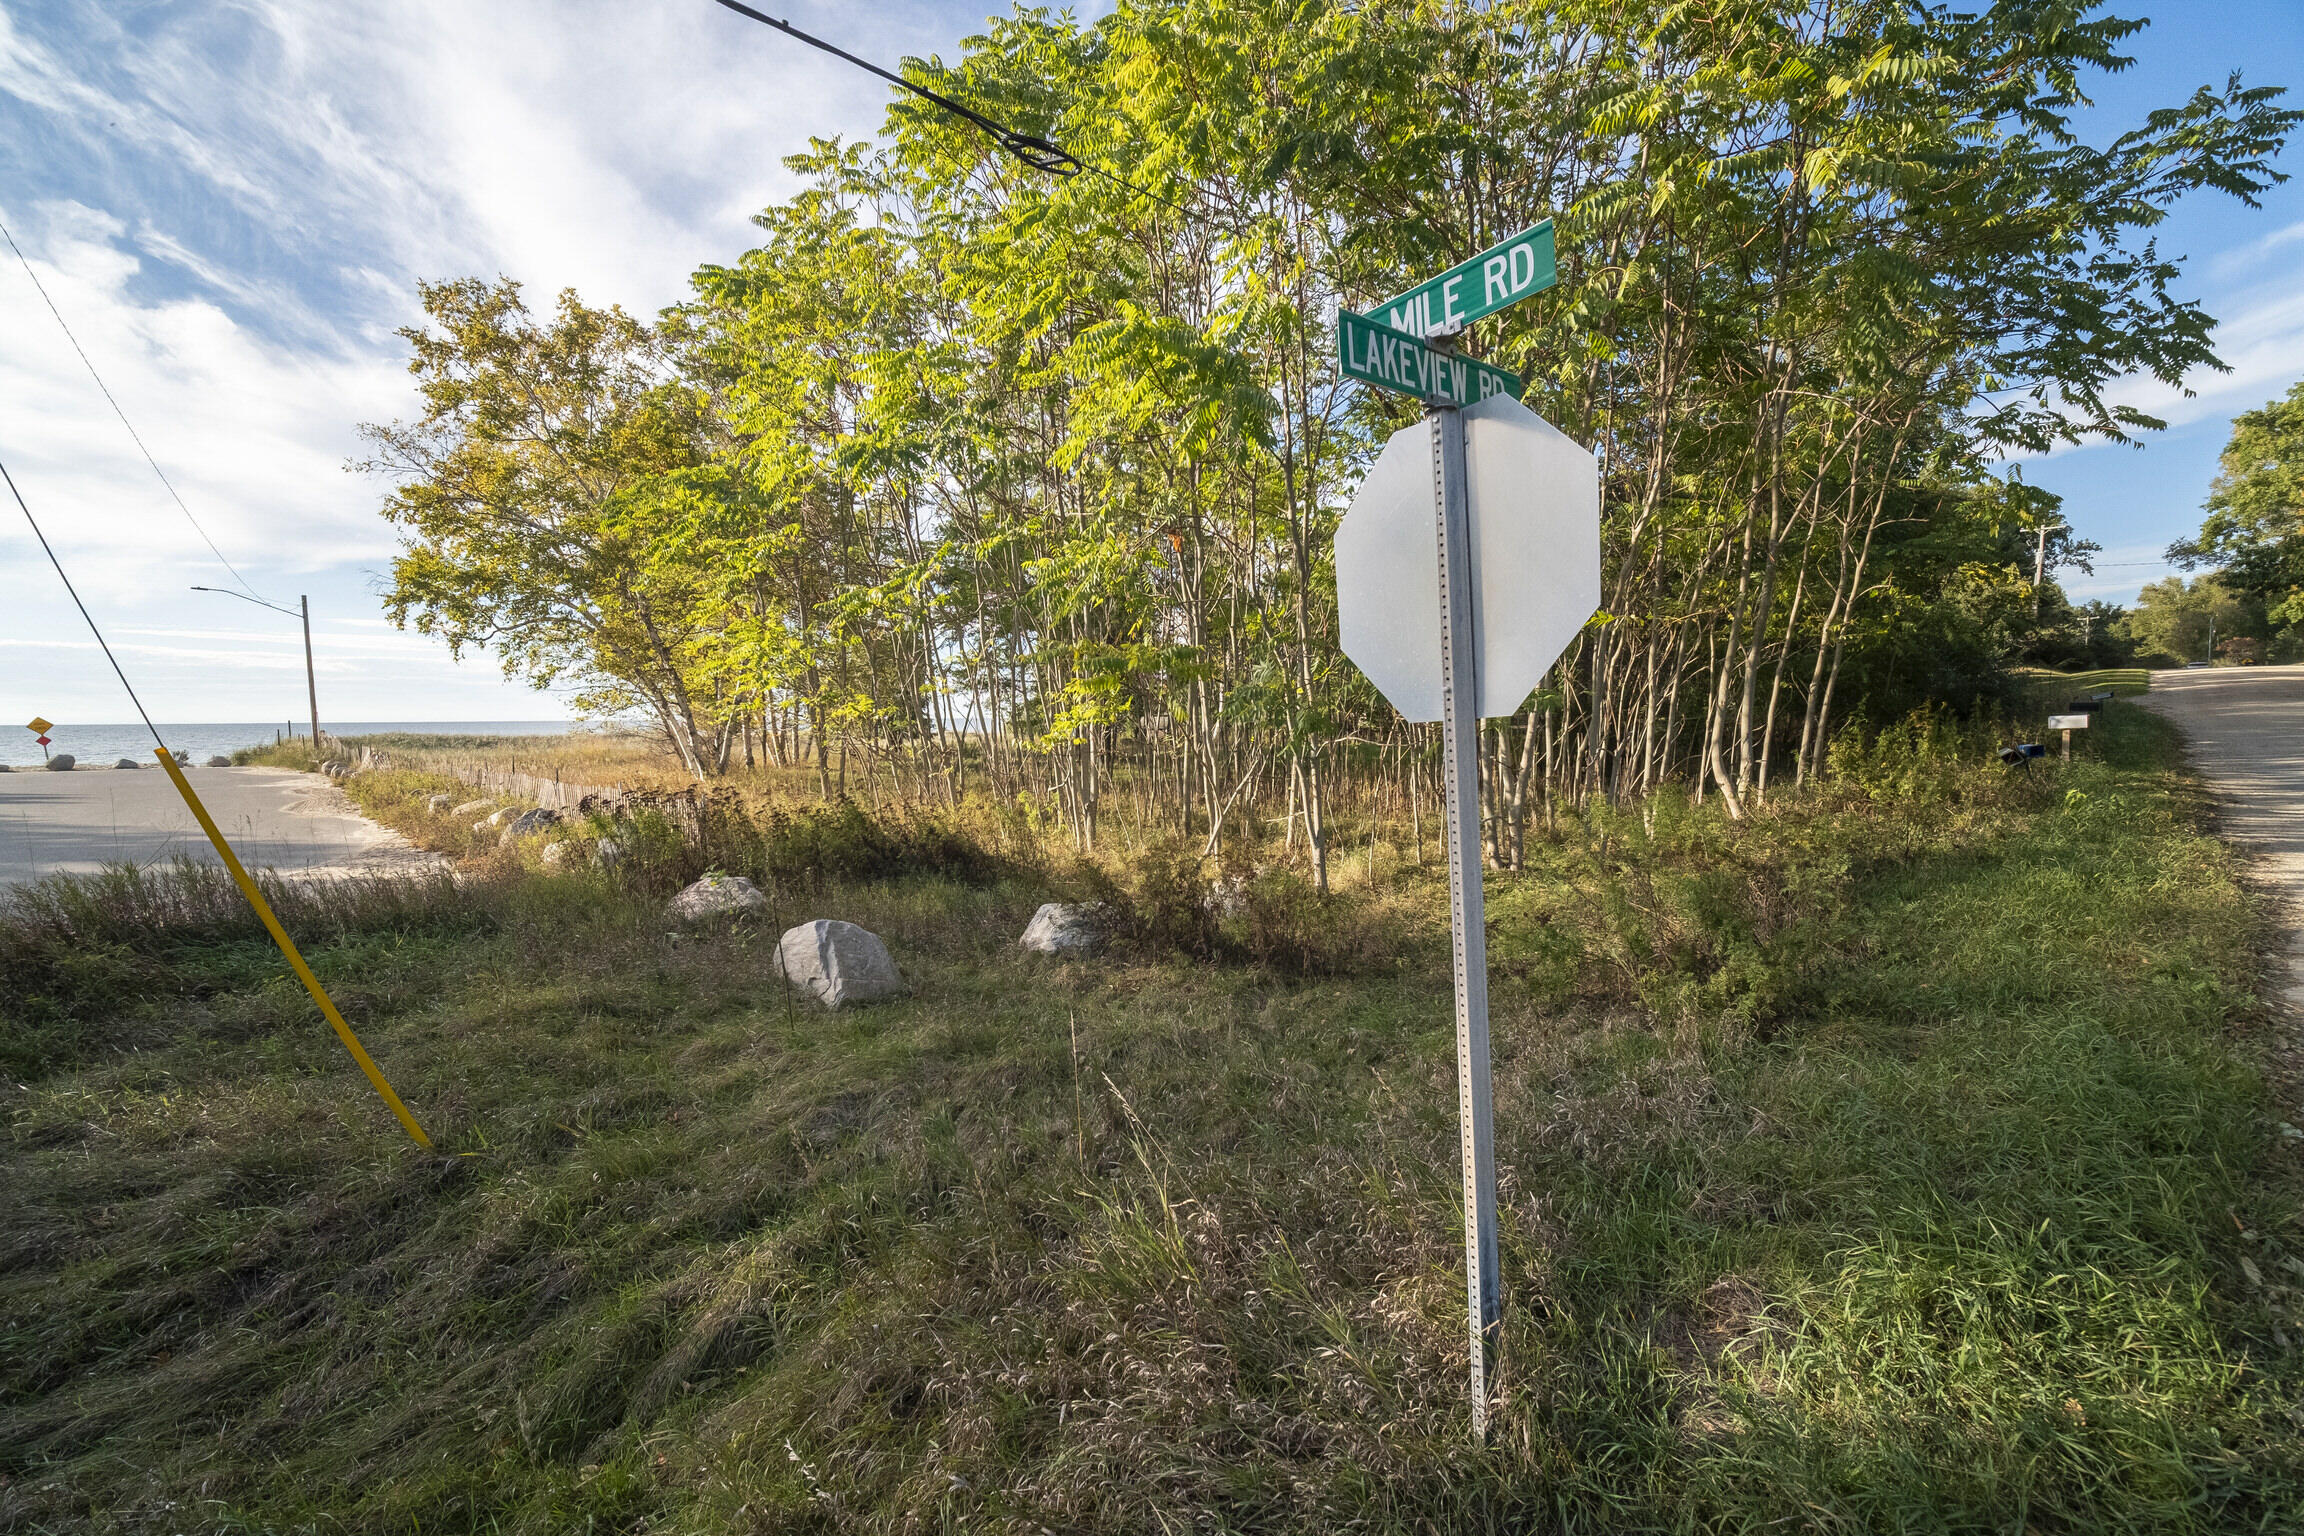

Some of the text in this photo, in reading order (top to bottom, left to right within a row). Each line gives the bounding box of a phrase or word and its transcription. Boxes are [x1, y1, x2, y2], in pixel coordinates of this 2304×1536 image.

[1390, 243, 1535, 338] MILE RD
[1347, 322, 1467, 403] LAKEVIEW
